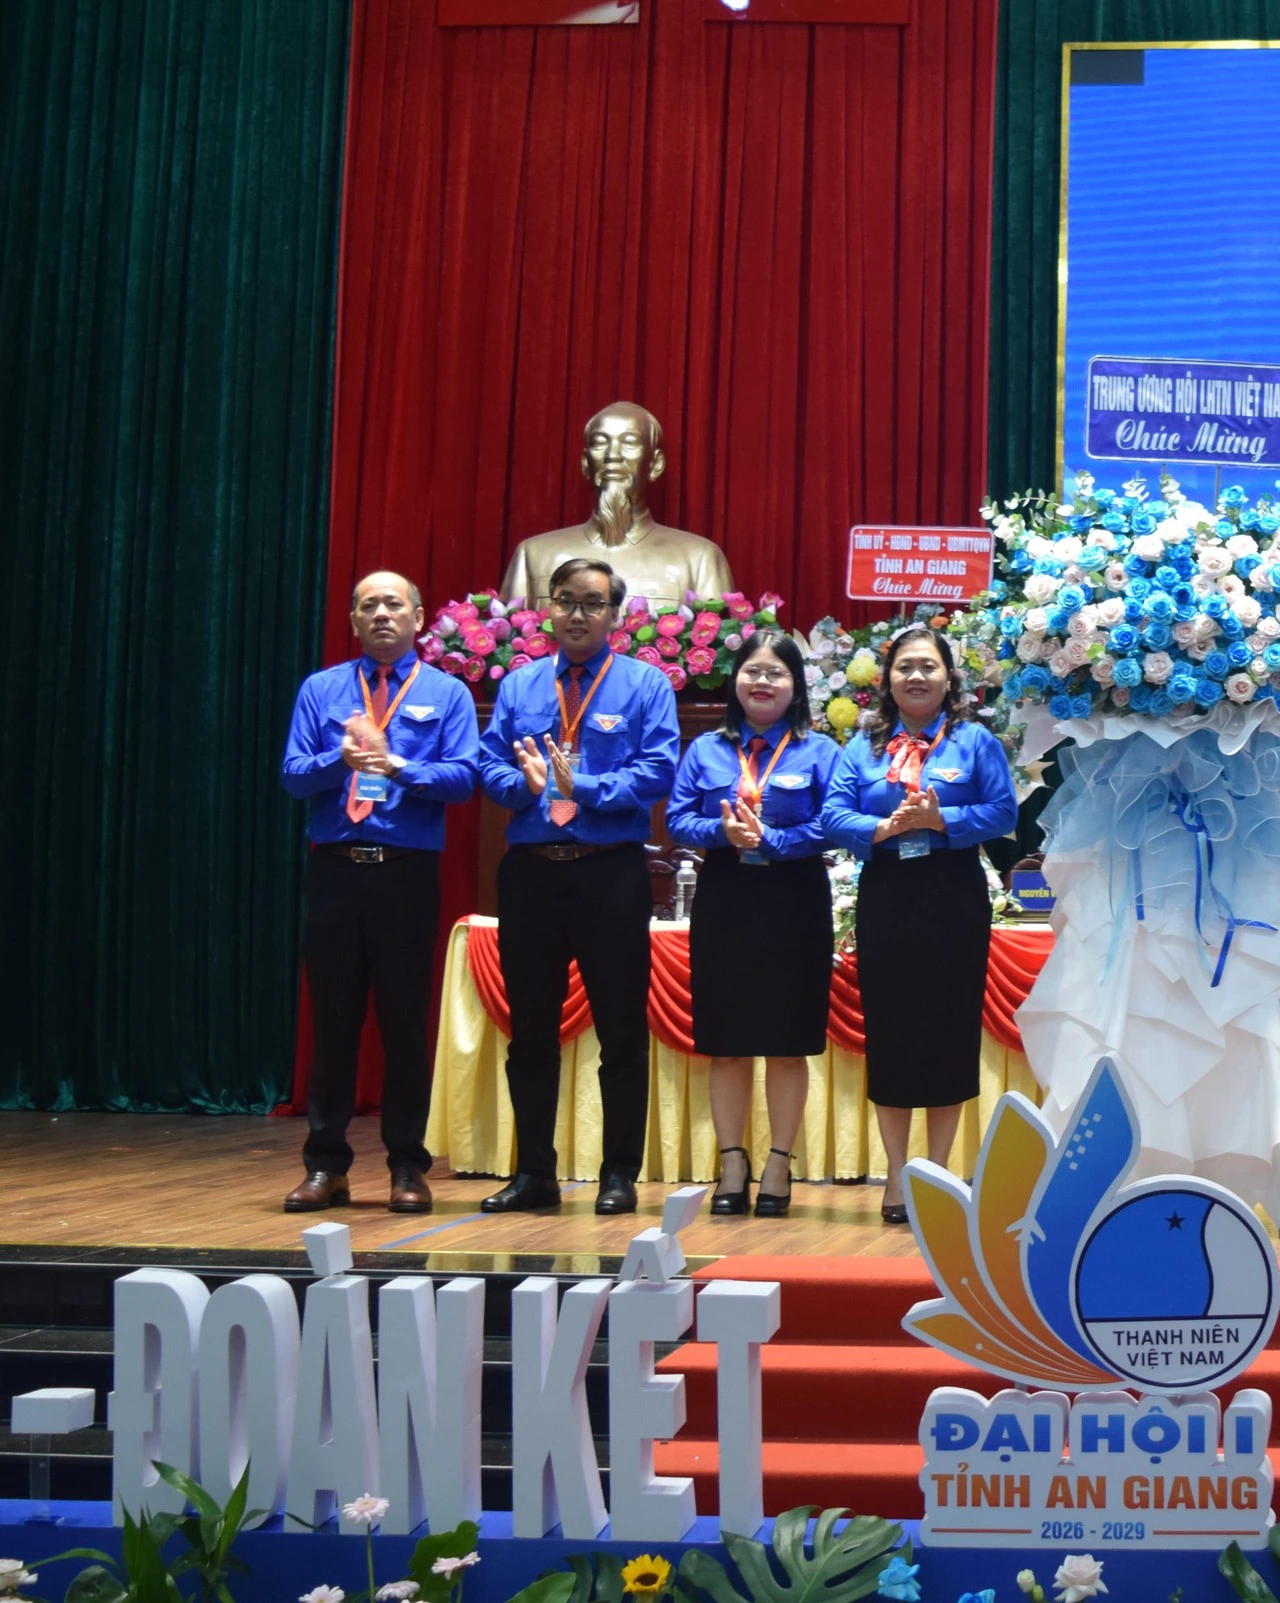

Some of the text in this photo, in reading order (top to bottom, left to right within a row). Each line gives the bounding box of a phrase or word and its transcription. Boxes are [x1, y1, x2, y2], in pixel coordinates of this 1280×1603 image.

[1093, 375, 1134, 412] TRUNG
[1138, 374, 1172, 413] ƯƠNG
[1176, 371, 1197, 422] HỘI
[1200, 379, 1231, 415] LHTN
[1235, 374, 1261, 425] VIỆT
[1116, 419, 1267, 463] Chúc Mừng
[874, 554, 967, 575] TỈNH AN GIANG
[872, 577, 963, 599] Chúc Mừng
[1113, 1323, 1240, 1347] THANH NIÊN
[108, 1222, 485, 1536] ĐOÀN
[513, 1186, 782, 1543] KẾT
[1127, 1347, 1224, 1370] VIỆT NAM
[930, 1406, 1253, 1464] ĐẠI HỘI I
[931, 1462, 1258, 1511] TỈNH AN GIANG
[1041, 1520, 1083, 1540] 2026
[1101, 1521, 1145, 1541] 2029
